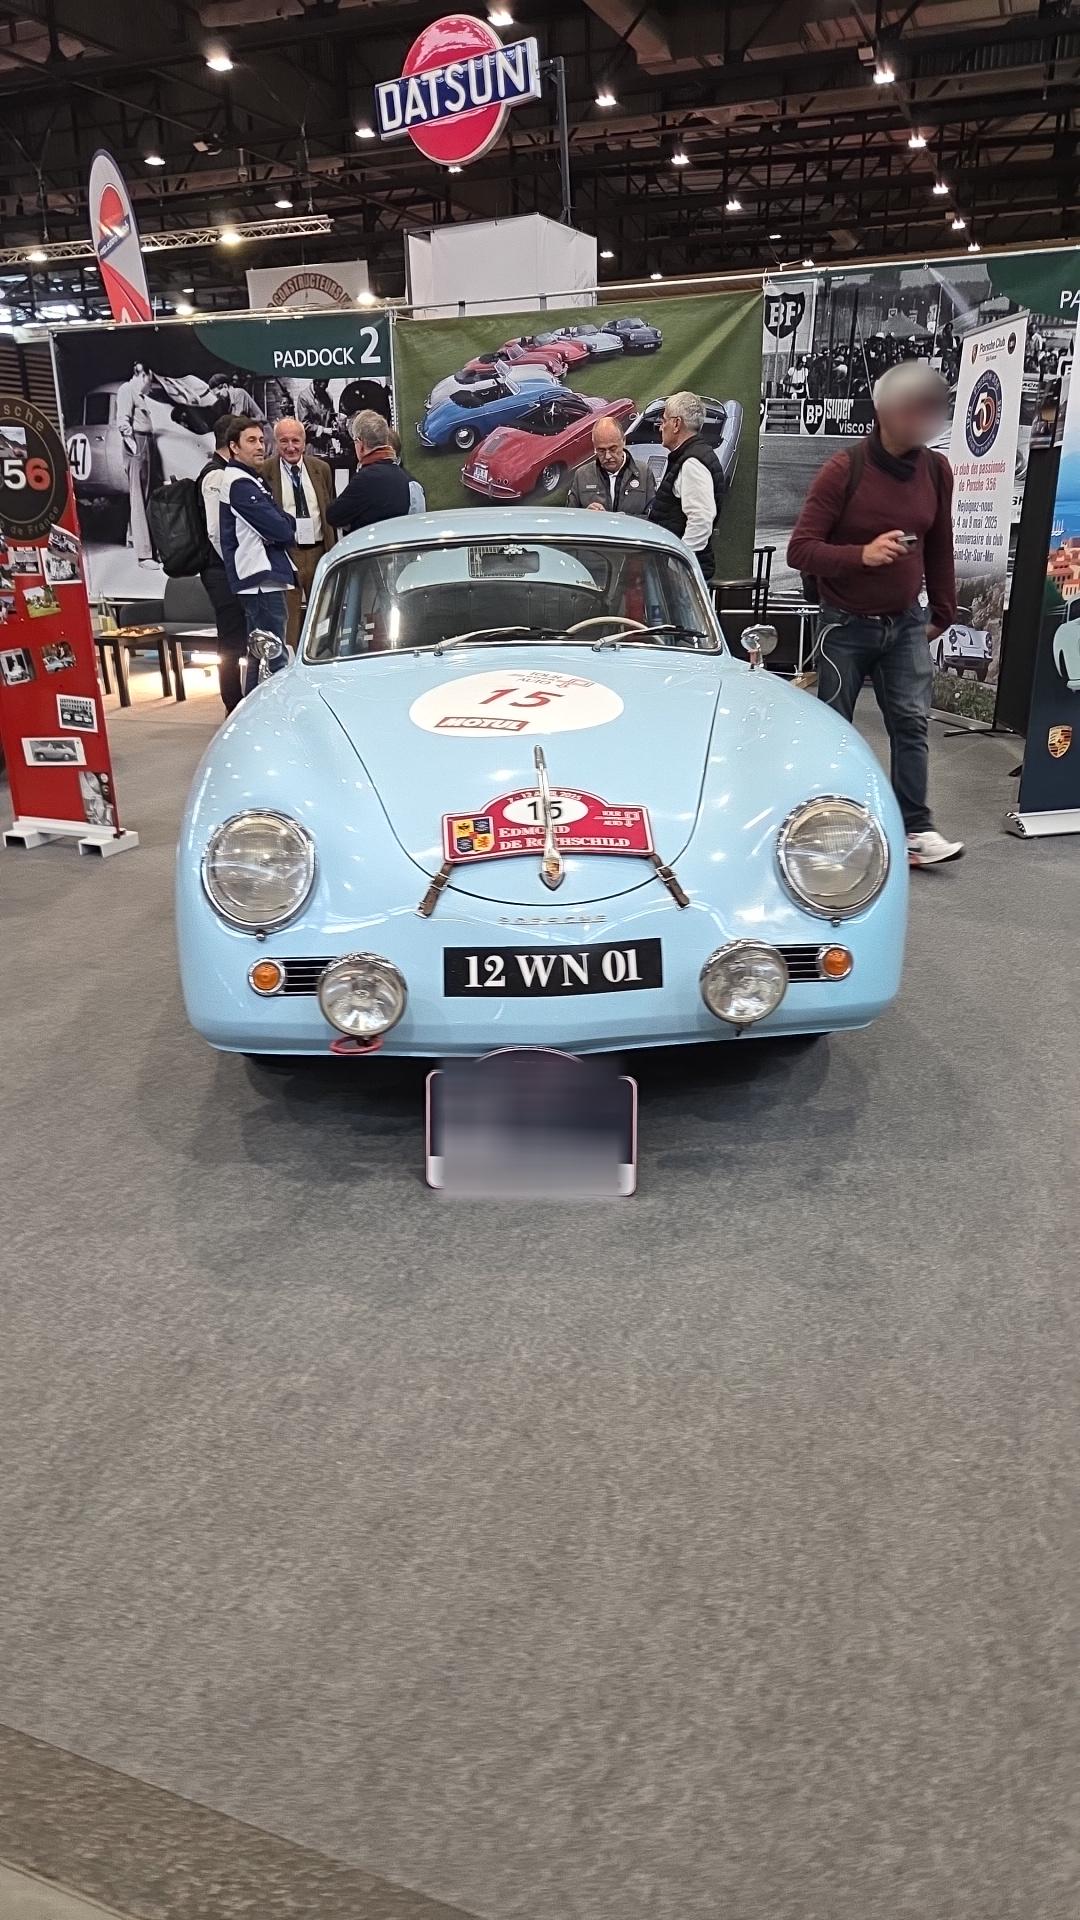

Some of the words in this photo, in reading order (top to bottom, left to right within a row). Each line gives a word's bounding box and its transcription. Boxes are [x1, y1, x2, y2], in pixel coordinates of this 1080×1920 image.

[379, 45, 526, 131] DATSUN
[272, 273, 343, 307] CONSTRUCTEURS
[273, 347, 355, 368] PADDOCK
[360, 326, 381, 364] 2
[980, 339, 995, 353] Porsche
[3, 404, 45, 432] sche
[806, 404, 823, 425] BP
[826, 399, 854, 424] super
[974, 392, 996, 438] 50
[839, 420, 865, 434] visco
[68, 438, 87, 475] 47
[0, 458, 51, 492] 56
[953, 549, 994, 562] aint-Cyr-Sur-Mer
[478, 688, 565, 707] 15
[444, 717, 524, 730] MOTUL
[527, 801, 562, 820] 15
[500, 840, 523, 850] DE
[525, 836, 630, 851] ROHSCHILD
[464, 955, 506, 988] 12
[514, 953, 590, 988] WN
[601, 949, 643, 983] 01
